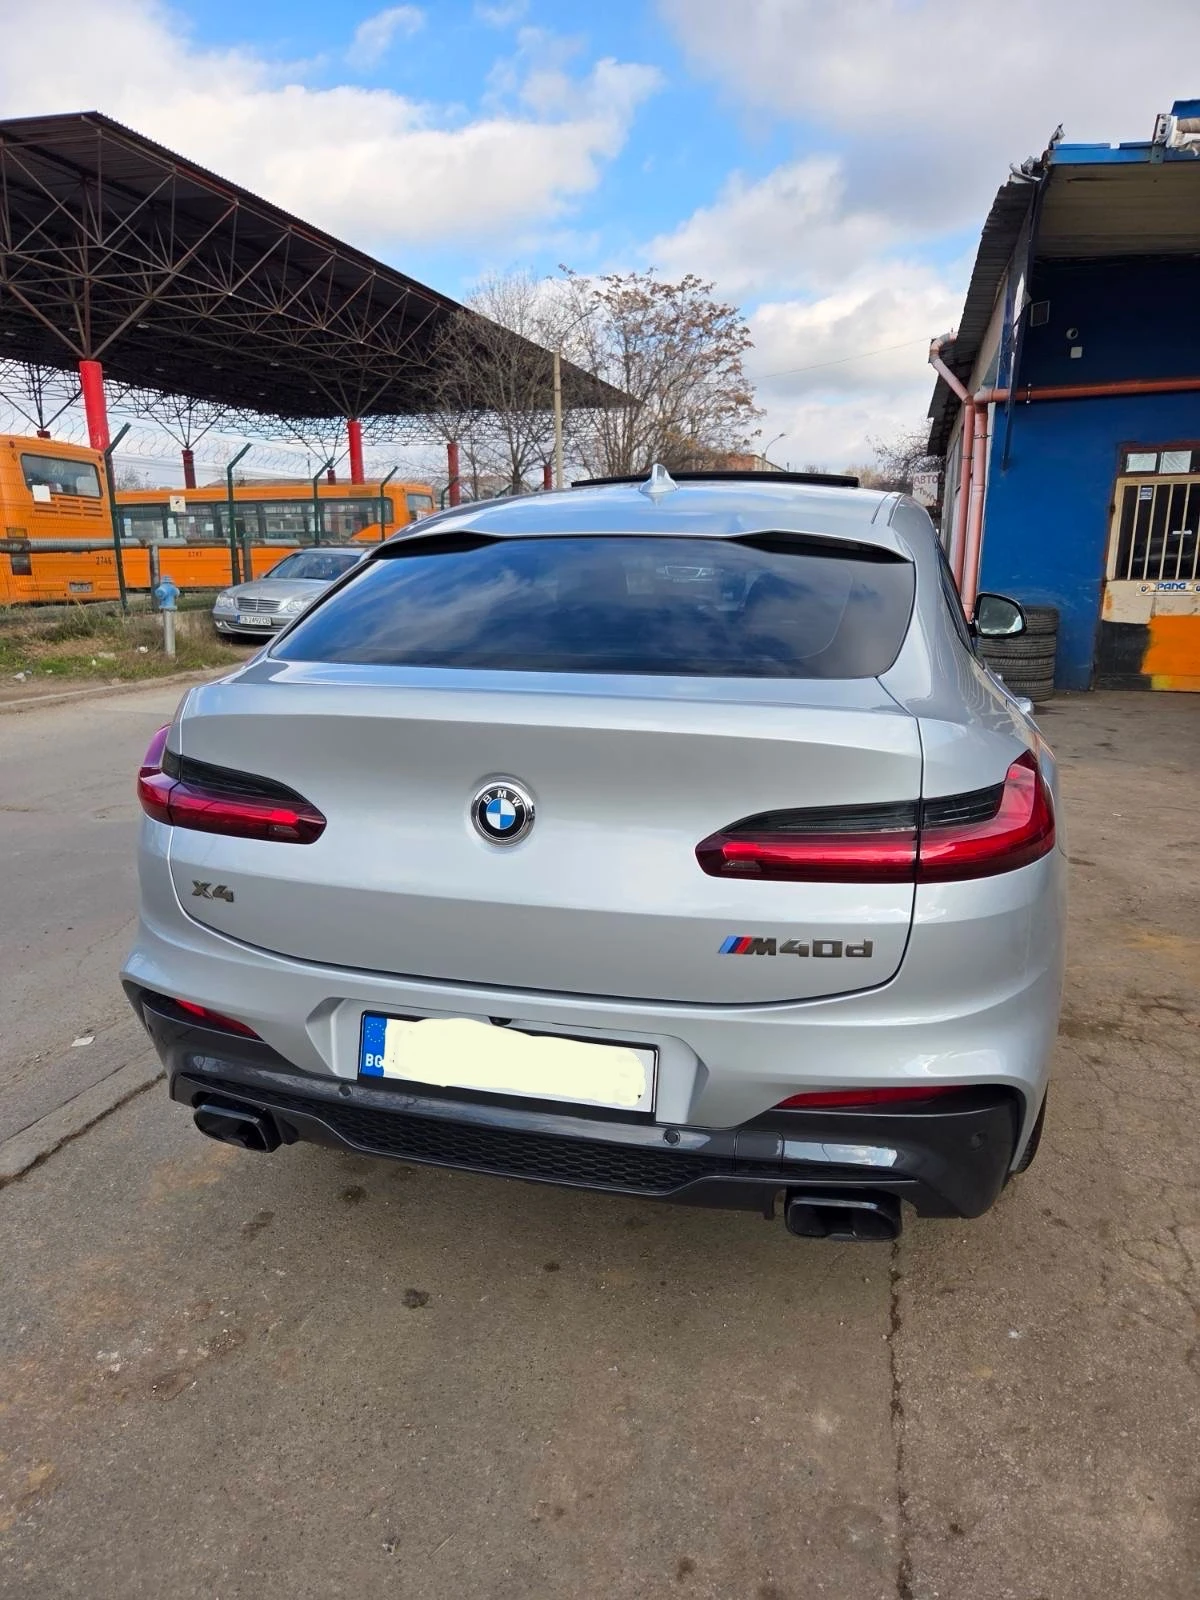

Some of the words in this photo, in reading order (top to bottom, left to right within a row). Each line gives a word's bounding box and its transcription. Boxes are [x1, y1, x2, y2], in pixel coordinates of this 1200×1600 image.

[482, 789, 523, 807] BMW
[191, 879, 234, 903] X4
[365, 1053, 384, 1068] BG
